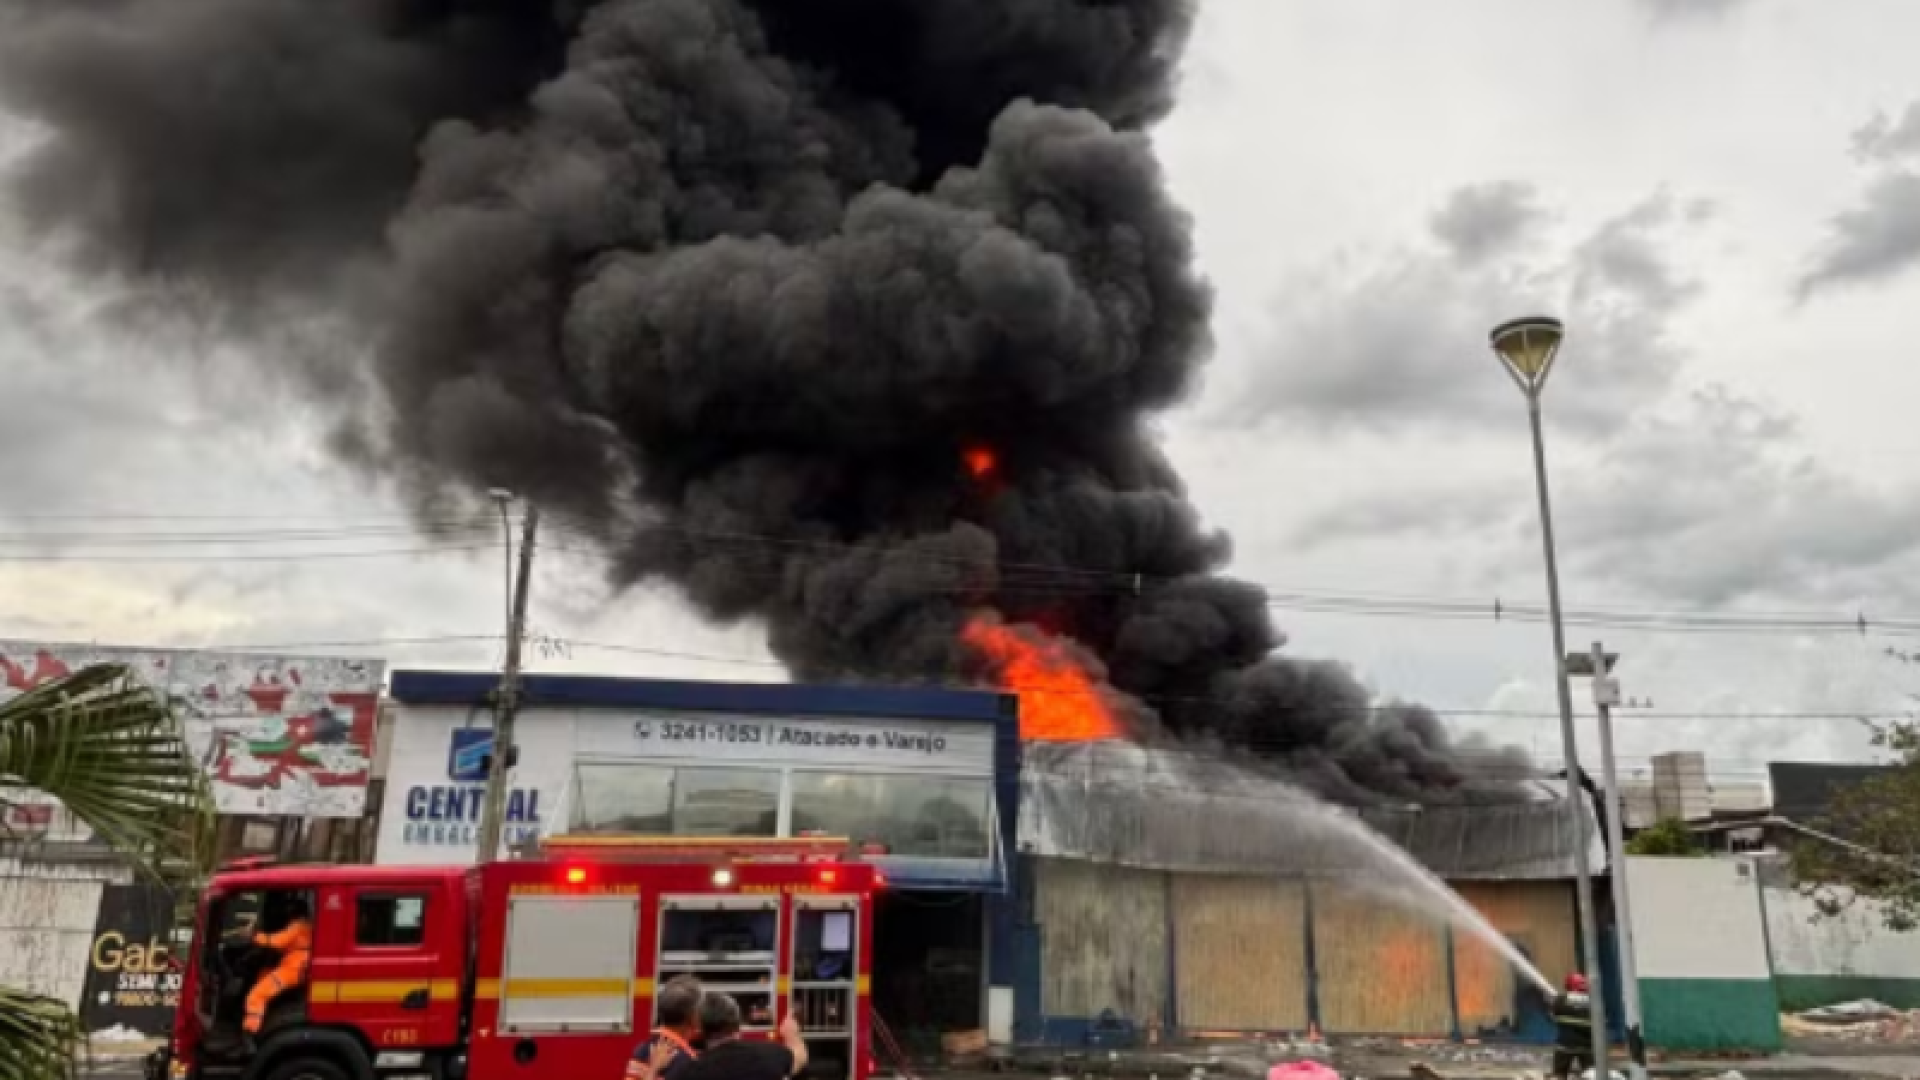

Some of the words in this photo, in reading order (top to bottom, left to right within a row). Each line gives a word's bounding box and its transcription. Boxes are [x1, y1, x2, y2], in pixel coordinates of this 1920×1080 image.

[779, 726, 860, 747] Atacado
[866, 733, 878, 747] e
[882, 731, 946, 754] Varejo
[405, 785, 540, 822] CENTAL
